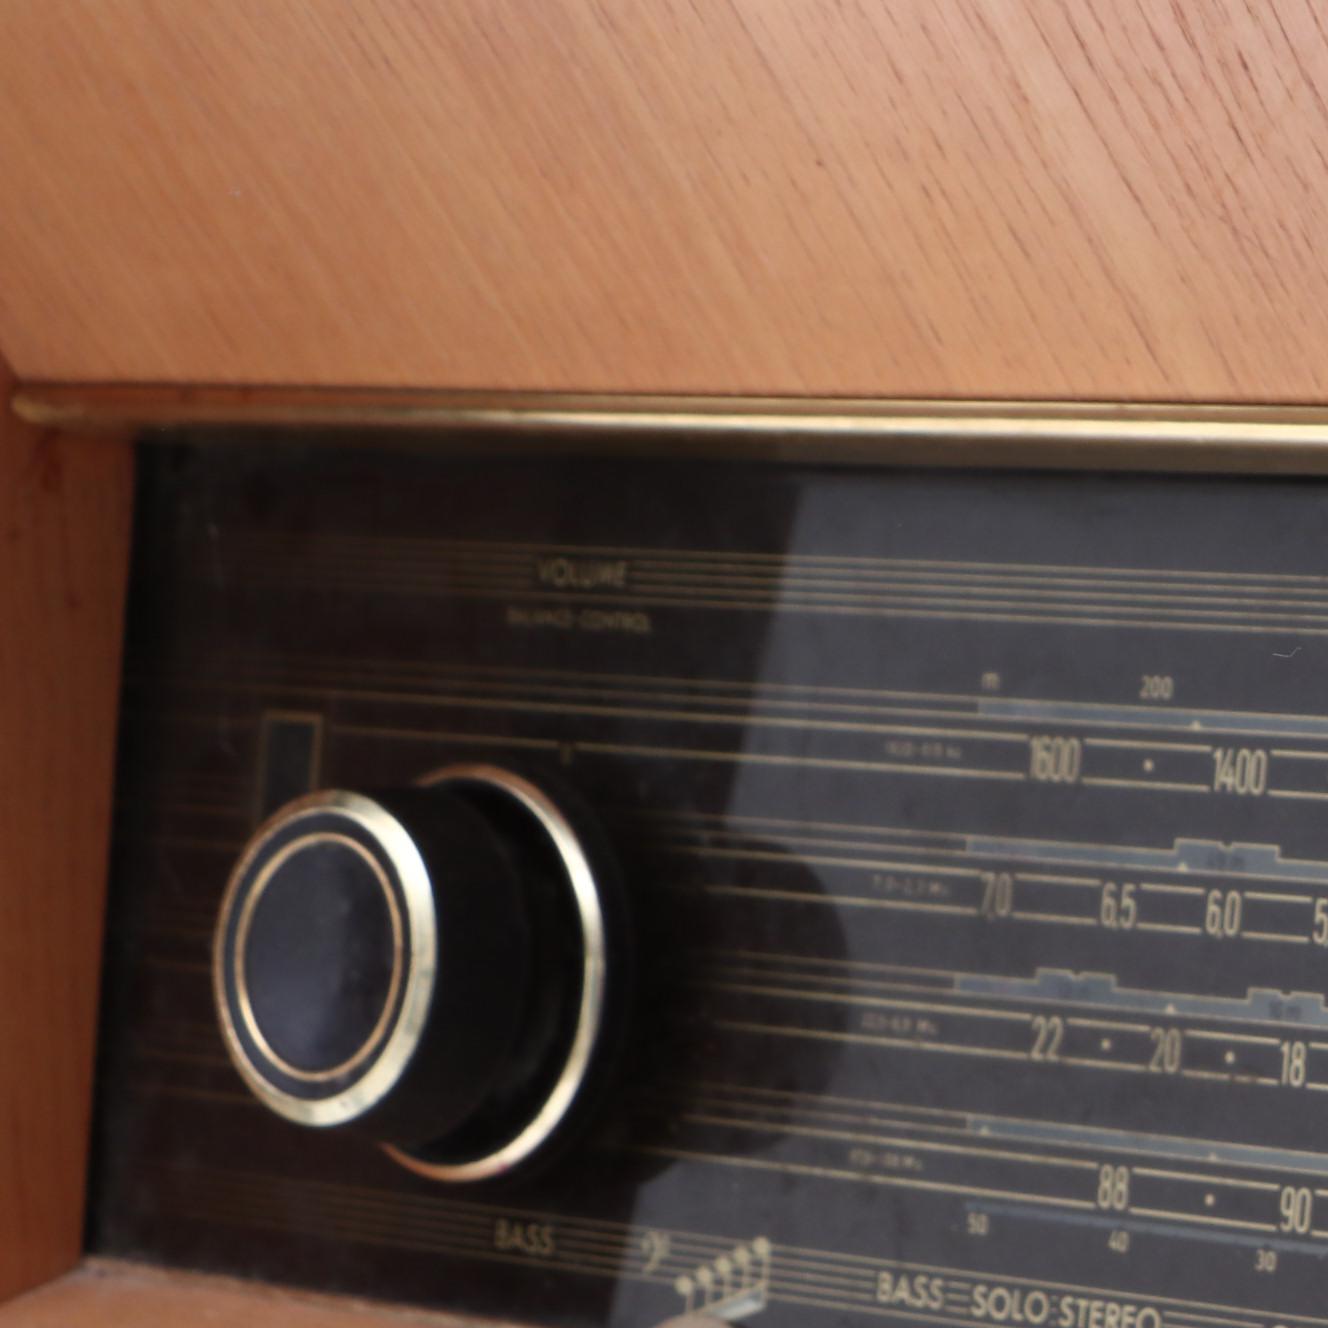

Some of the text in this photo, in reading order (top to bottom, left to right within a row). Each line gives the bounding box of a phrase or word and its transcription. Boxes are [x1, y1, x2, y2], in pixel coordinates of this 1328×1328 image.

[1140, 676, 1173, 699] 200
[1030, 738, 1081, 783] 1600
[1213, 749, 1267, 795] 1400
[1031, 1016, 1063, 1060] 22
[1149, 1027, 1181, 1072] 20
[1281, 1042, 1306, 1087] 18
[1097, 1165, 1129, 1209] 88
[1280, 1187, 1311, 1234] 90
[495, 1221, 554, 1255] BASS
[1255, 1250, 1276, 1272] 30
[878, 1272, 944, 1309] BASS
[971, 1286, 1048, 1325] SOLO
